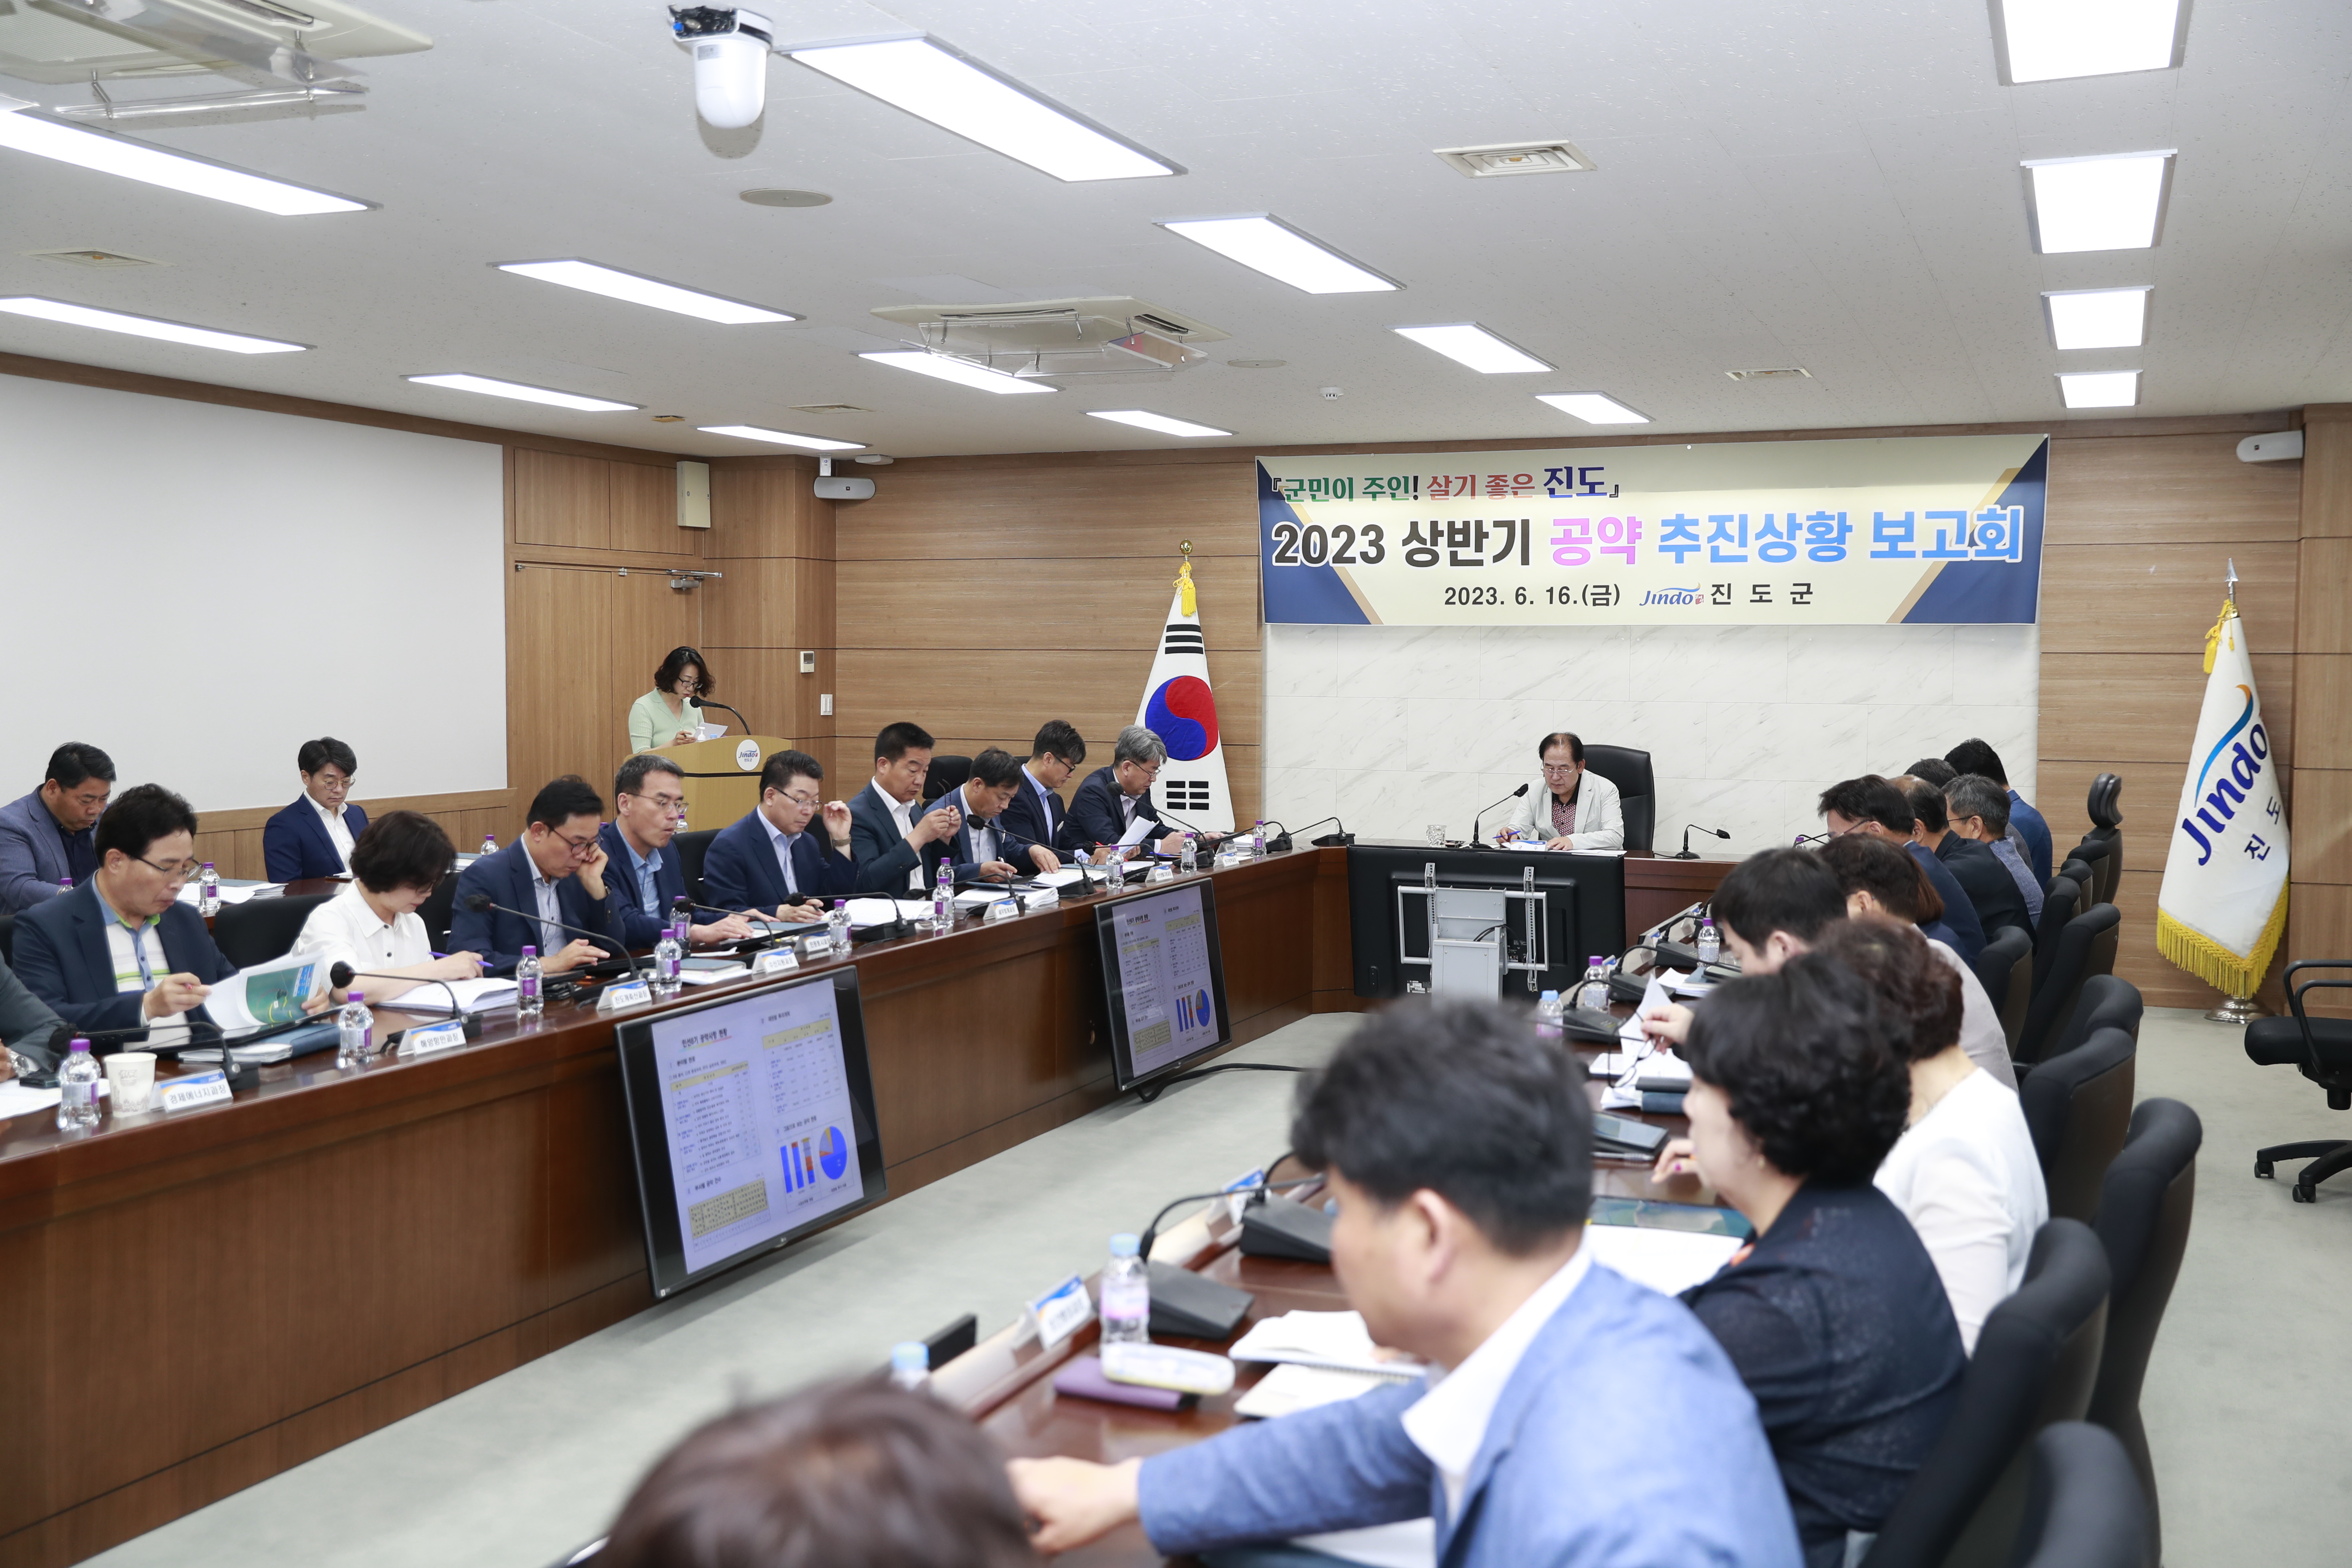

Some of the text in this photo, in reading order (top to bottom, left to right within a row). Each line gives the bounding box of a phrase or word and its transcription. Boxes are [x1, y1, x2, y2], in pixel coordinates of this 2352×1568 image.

[1362, 475, 1419, 502] 주인!
[1426, 474, 1476, 500] 살기
[1485, 473, 1535, 500] 좋은
[1274, 508, 2021, 568] 2023 상반기 공약 추진상황 보고회
[1444, 586, 1504, 606] 2023.
[1515, 586, 1534, 605] 6.
[1546, 583, 1621, 607] 16.(금)
[1639, 590, 1693, 606] Jindo
[2181, 723, 2268, 866] Jindo
[420, 1032, 459, 1048] 해양항만과장
[170, 1084, 227, 1104] 경제에너지과장
